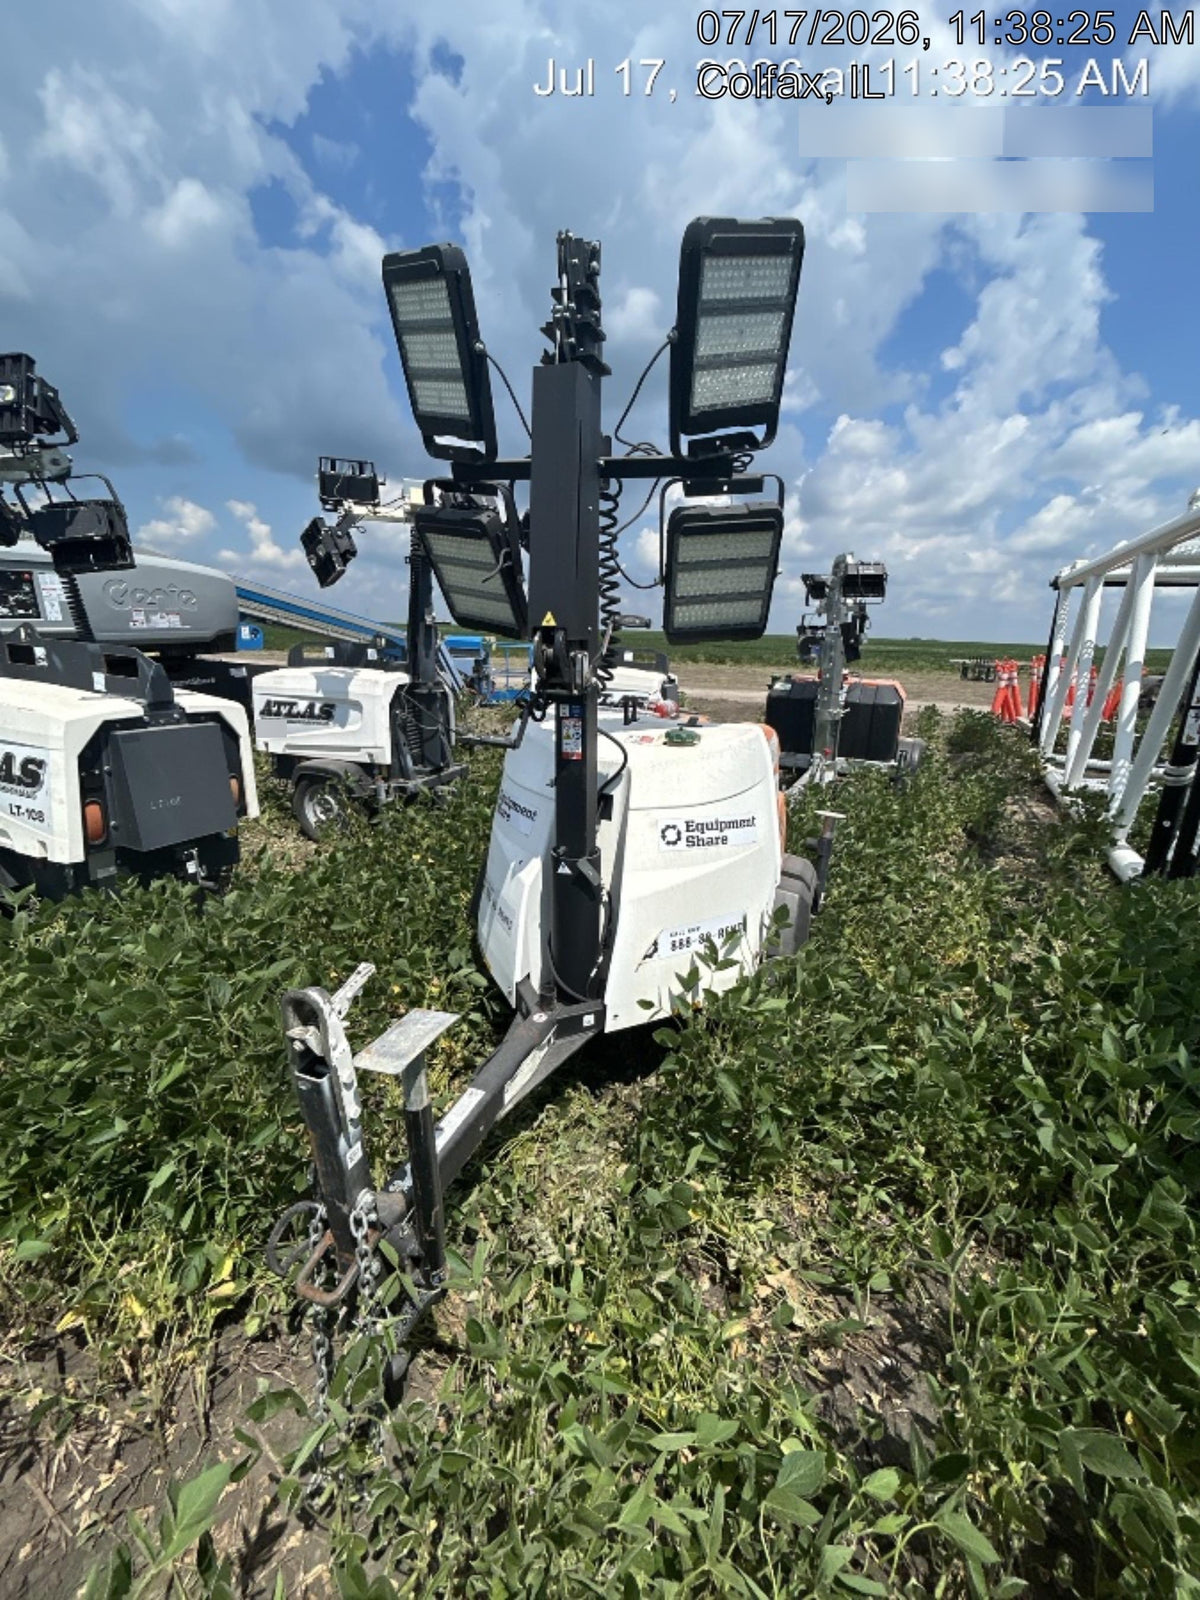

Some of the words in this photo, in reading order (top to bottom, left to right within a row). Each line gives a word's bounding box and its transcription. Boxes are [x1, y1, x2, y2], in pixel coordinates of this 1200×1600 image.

[258, 699, 337, 721] ATLAS
[684, 815, 756, 835] Equipment
[685, 834, 729, 848] Share
